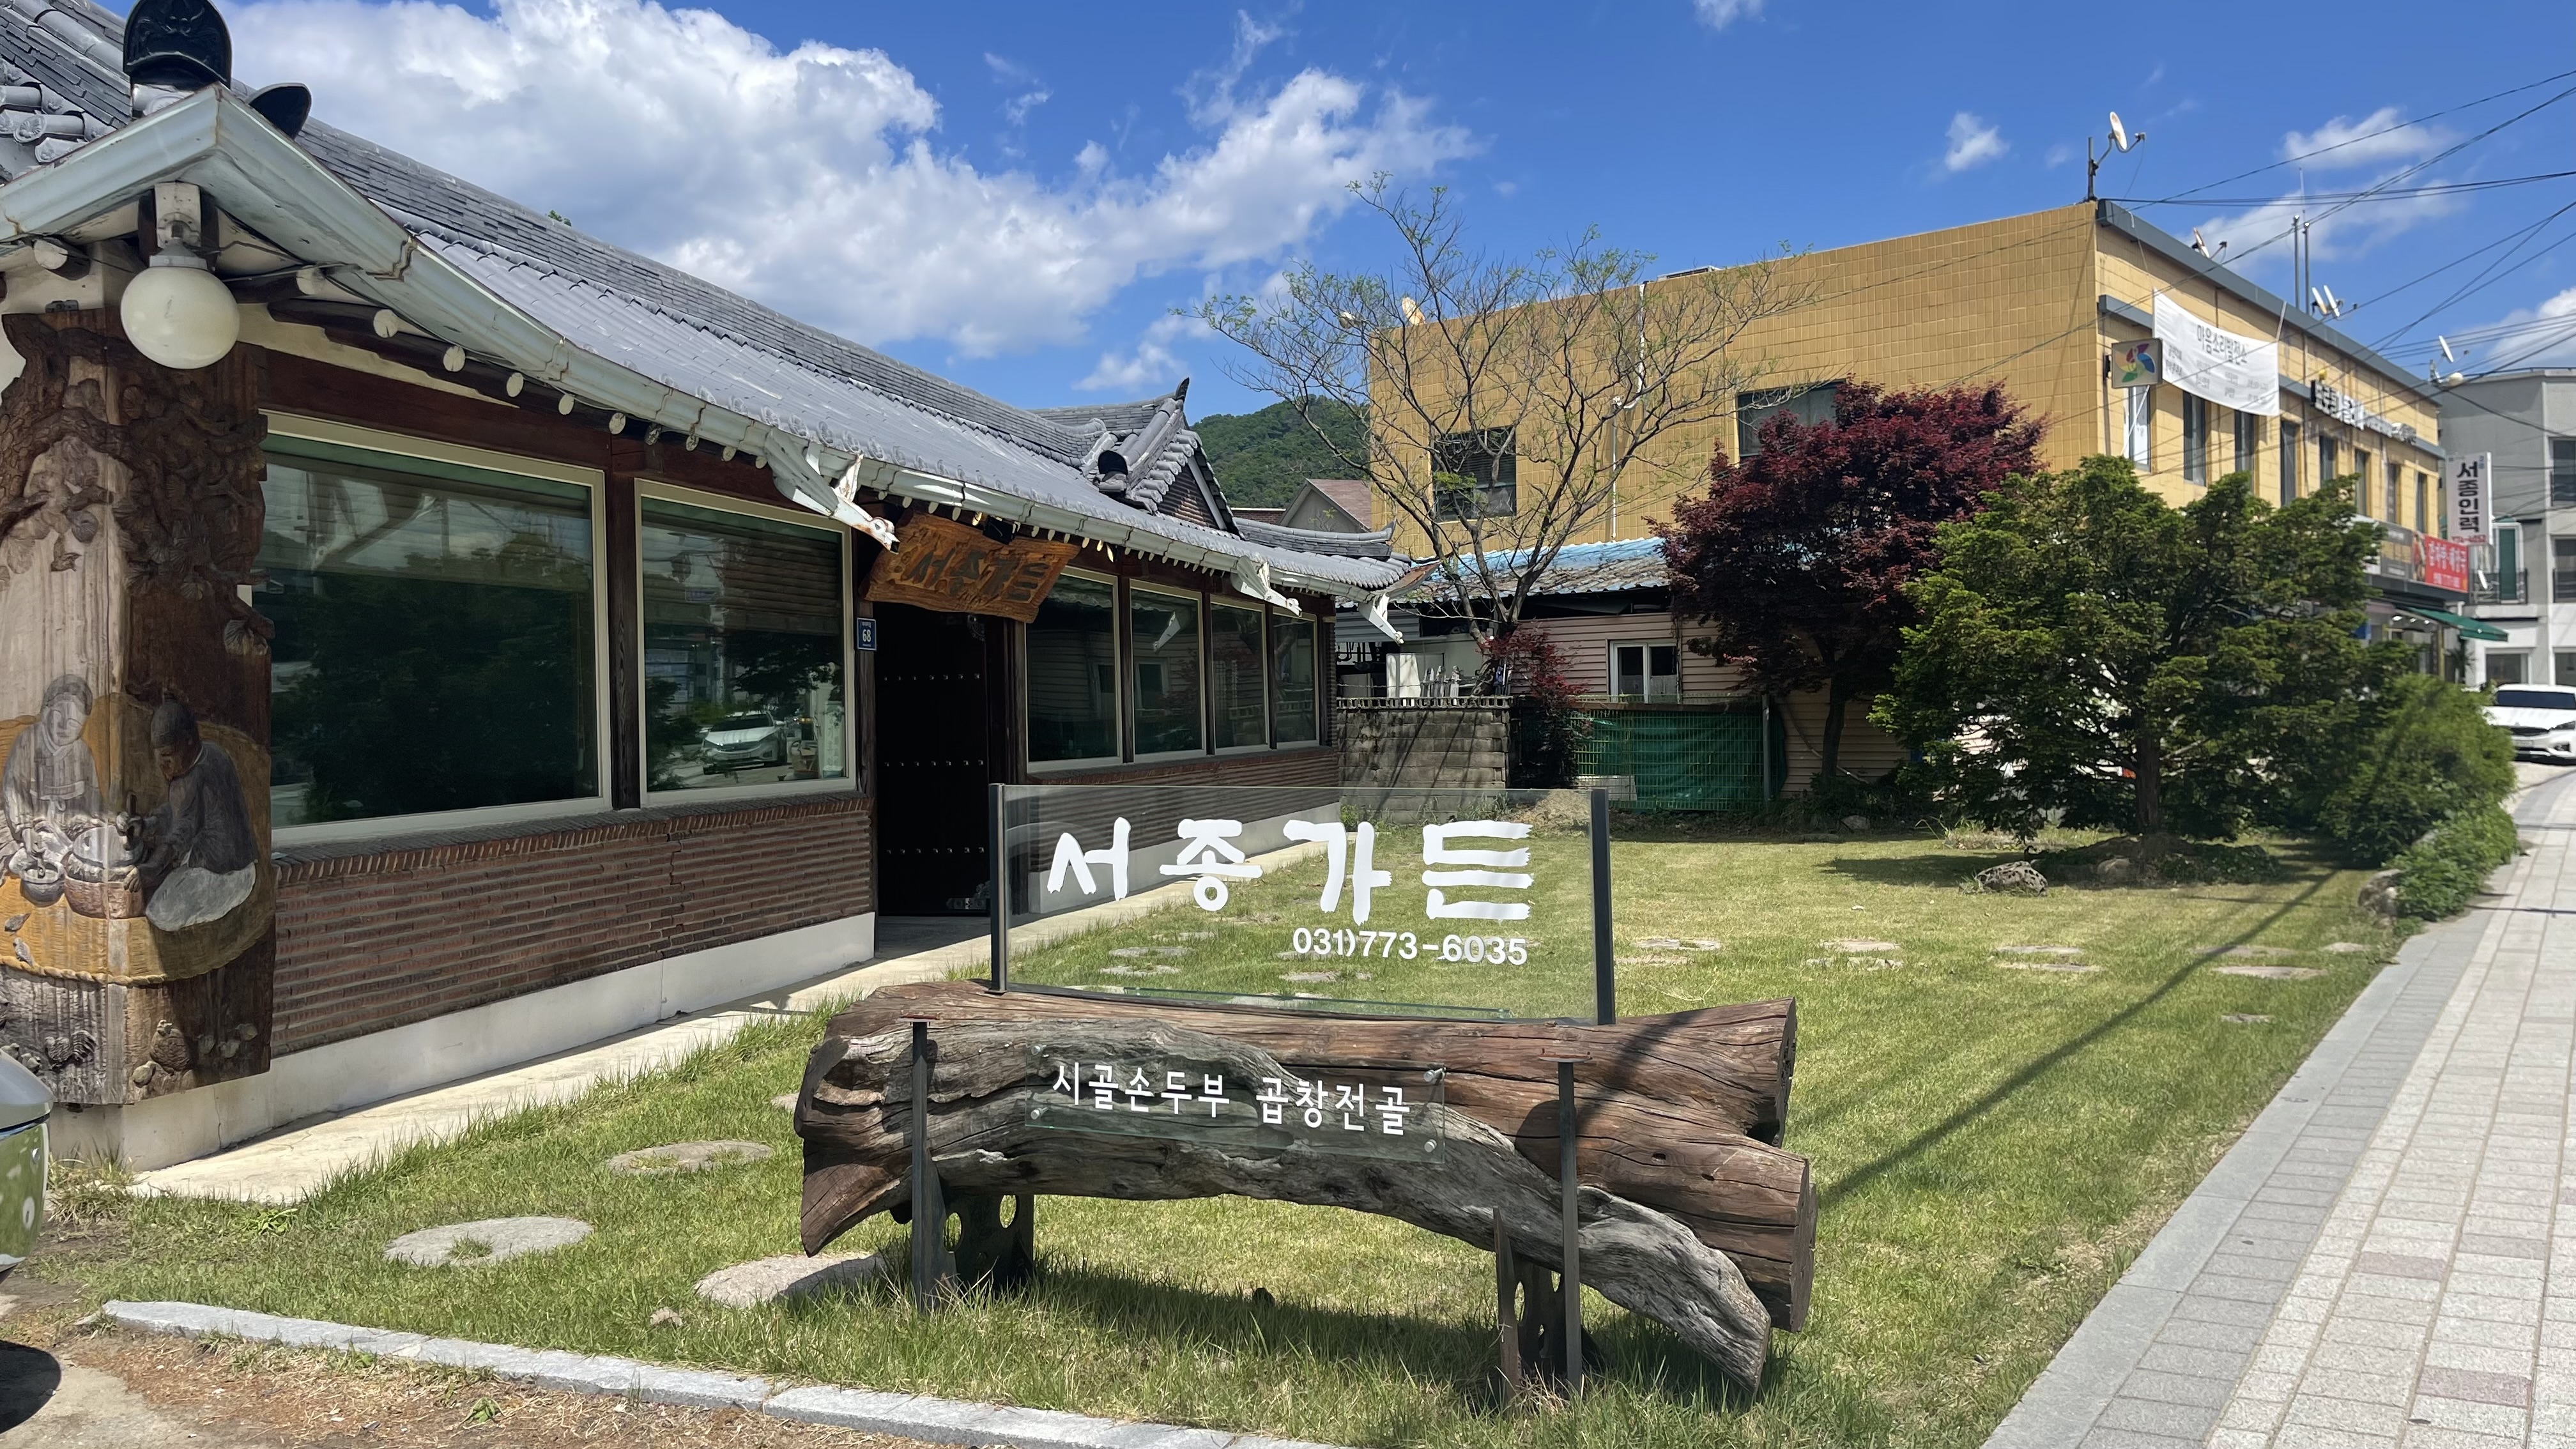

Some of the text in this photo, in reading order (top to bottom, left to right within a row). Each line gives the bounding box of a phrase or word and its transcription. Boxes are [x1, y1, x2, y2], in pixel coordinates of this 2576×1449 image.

[2456, 461, 2480, 533] 서종인력
[862, 629, 871, 643] 68
[1046, 817, 1534, 926] 서종가든
[1292, 926, 1527, 966] 031)773-6035
[1052, 1062, 1410, 1136] 시골손두부 곱창전골
